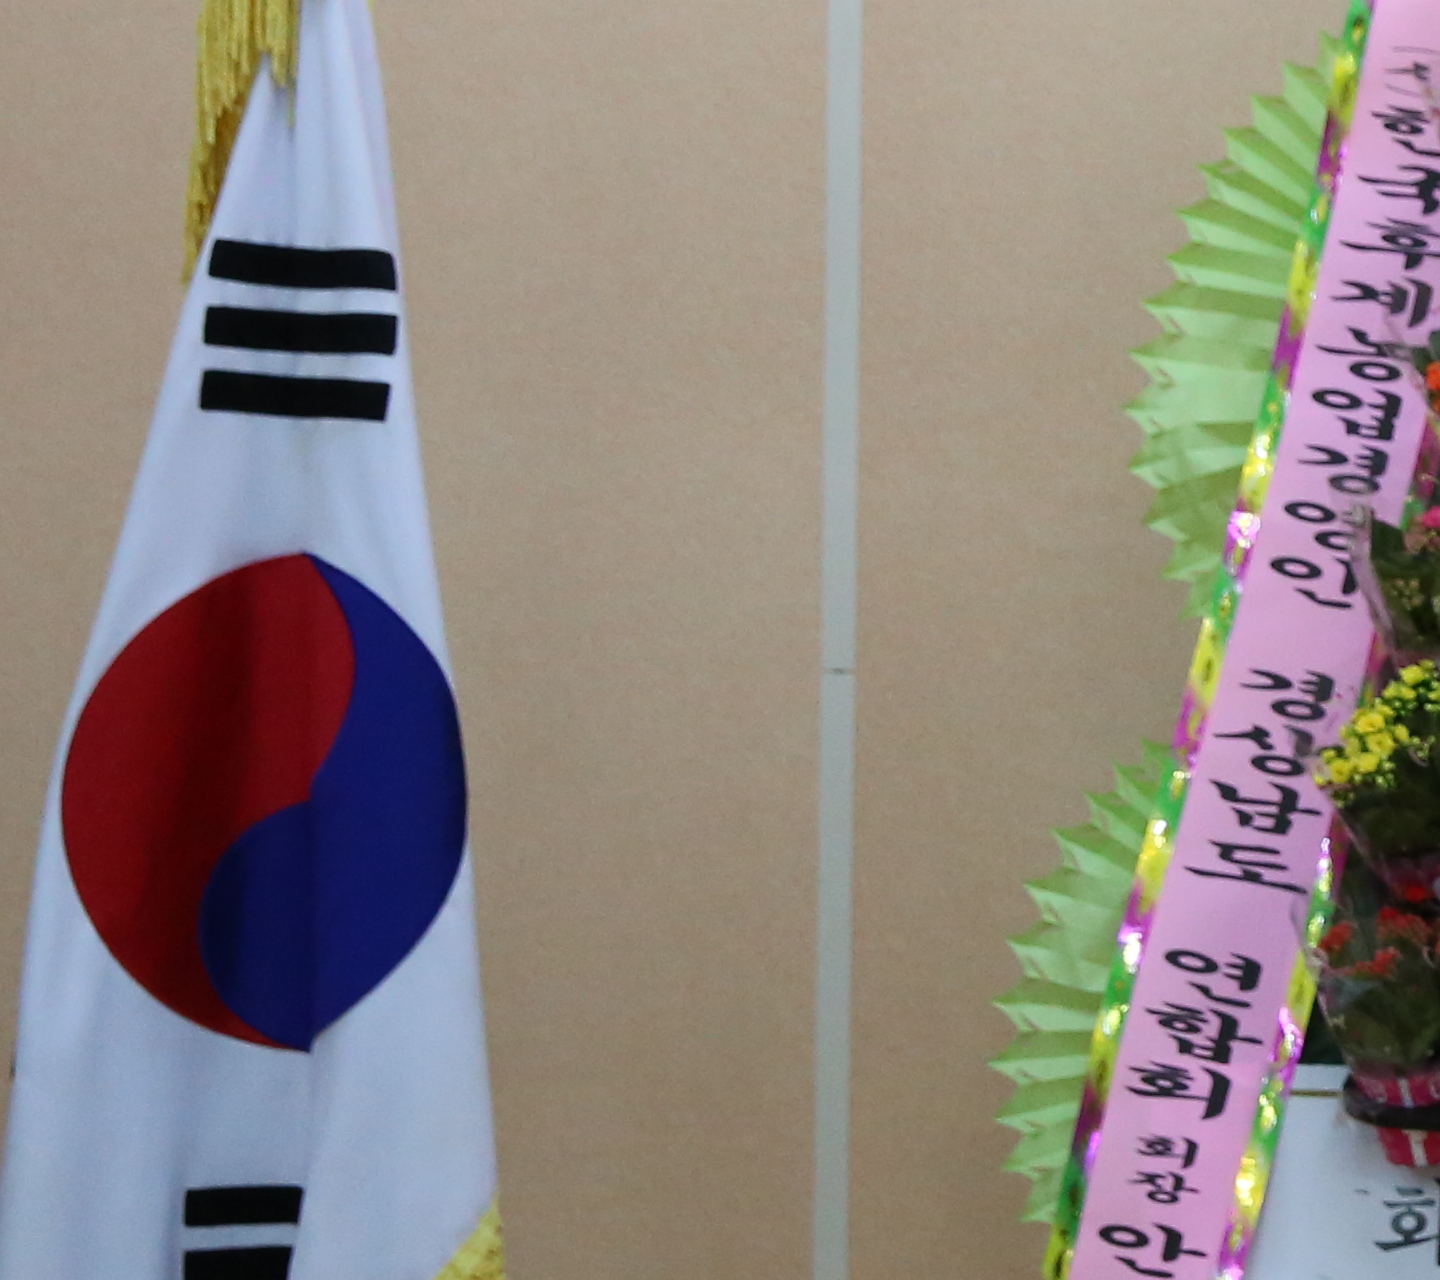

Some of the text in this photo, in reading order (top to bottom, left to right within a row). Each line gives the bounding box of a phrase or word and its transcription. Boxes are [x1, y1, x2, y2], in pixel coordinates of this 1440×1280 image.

[1183, 670, 1335, 893] 경상남도
[1126, 950, 1263, 1119] 연합회
[1129, 1135, 1200, 1204] 회장
